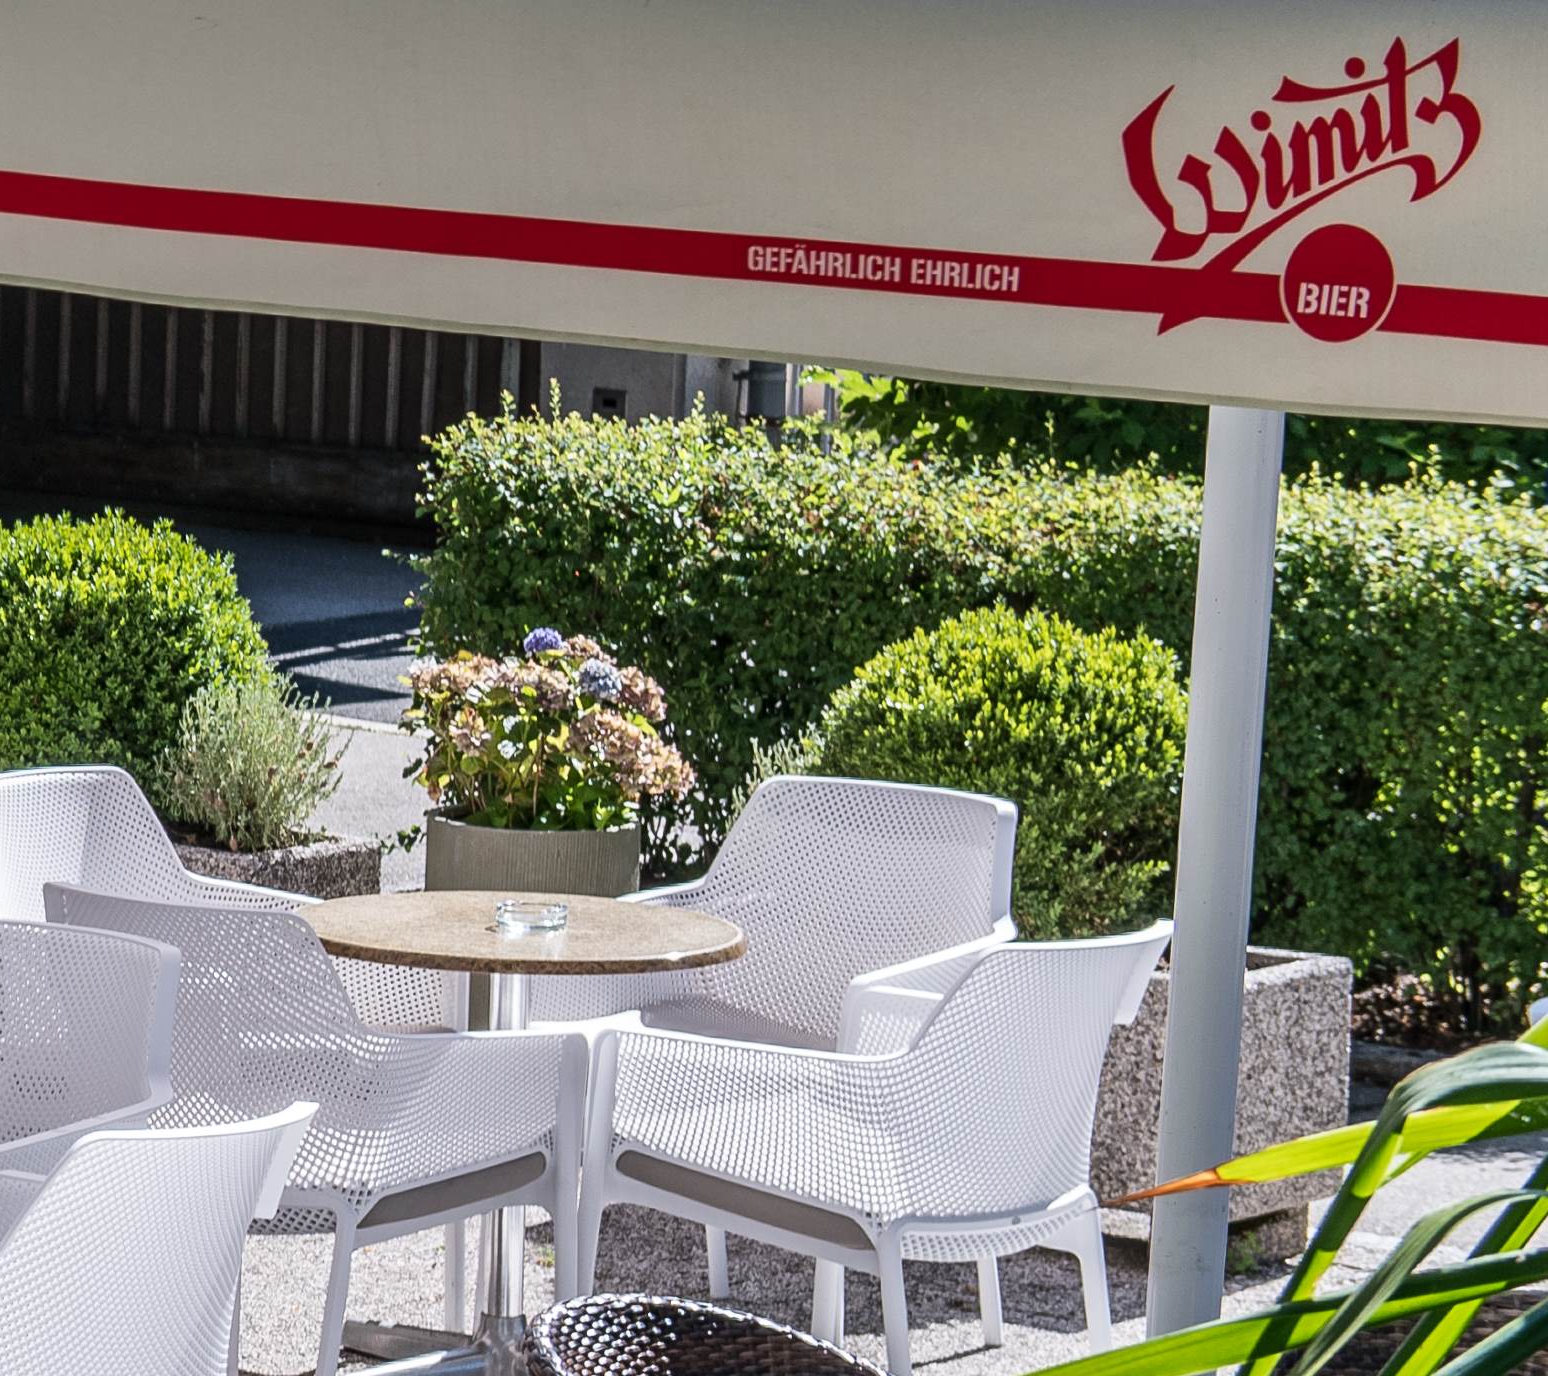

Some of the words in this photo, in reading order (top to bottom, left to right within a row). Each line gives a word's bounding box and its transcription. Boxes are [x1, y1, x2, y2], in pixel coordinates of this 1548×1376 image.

[1122, 37, 1482, 264] Wimitz
[746, 243, 902, 283] GEFÄHRLICH
[910, 257, 1021, 293] EHRLICH
[1296, 281, 1370, 319] BIER
